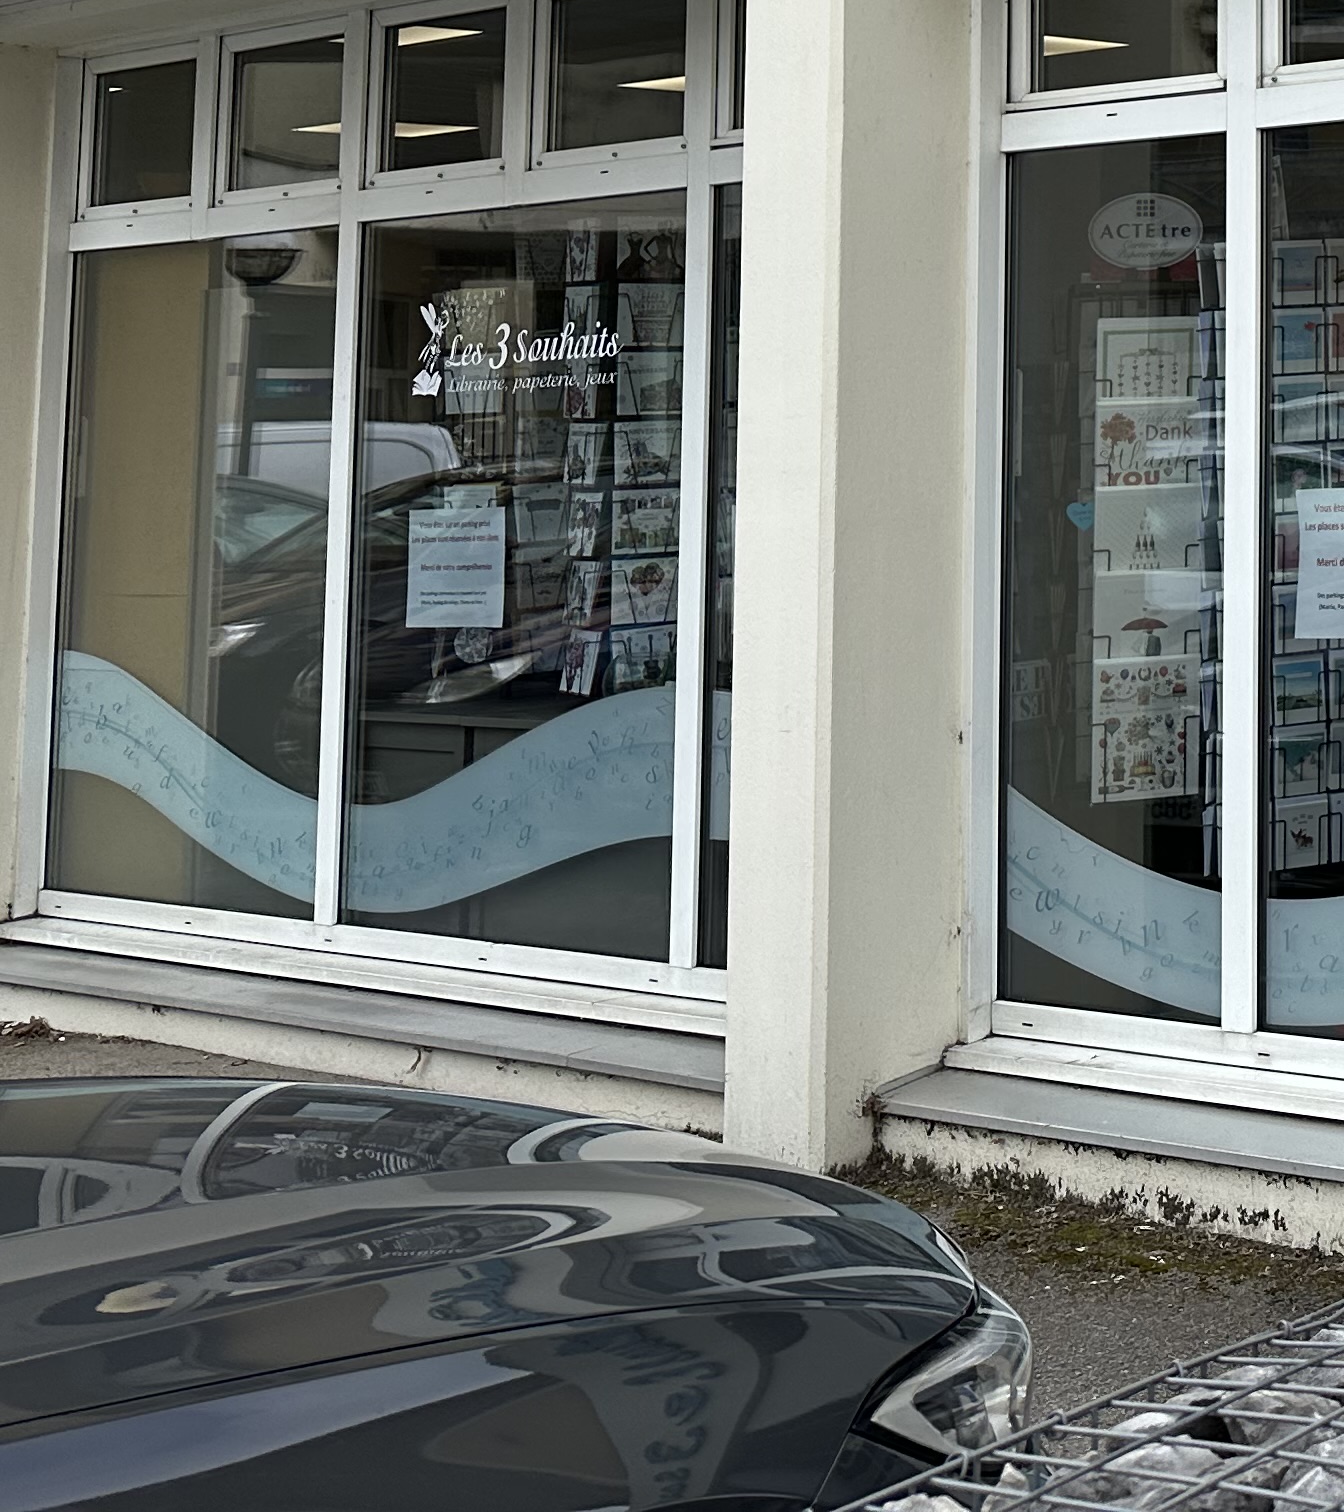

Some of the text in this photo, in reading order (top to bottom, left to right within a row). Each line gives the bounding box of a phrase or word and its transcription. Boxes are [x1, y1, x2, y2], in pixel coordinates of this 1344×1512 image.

[444, 321, 625, 370] Les 3 Souhaits
[511, 370, 580, 395] papeterie,
[584, 367, 618, 390] jeux
[1145, 421, 1193, 441] Dank
[1107, 470, 1161, 486] YOU
[1313, 503, 1332, 513] Vous
[1305, 521, 1316, 531] Les
[1317, 521, 1339, 532] places
[1316, 557, 1338, 567] Merci
